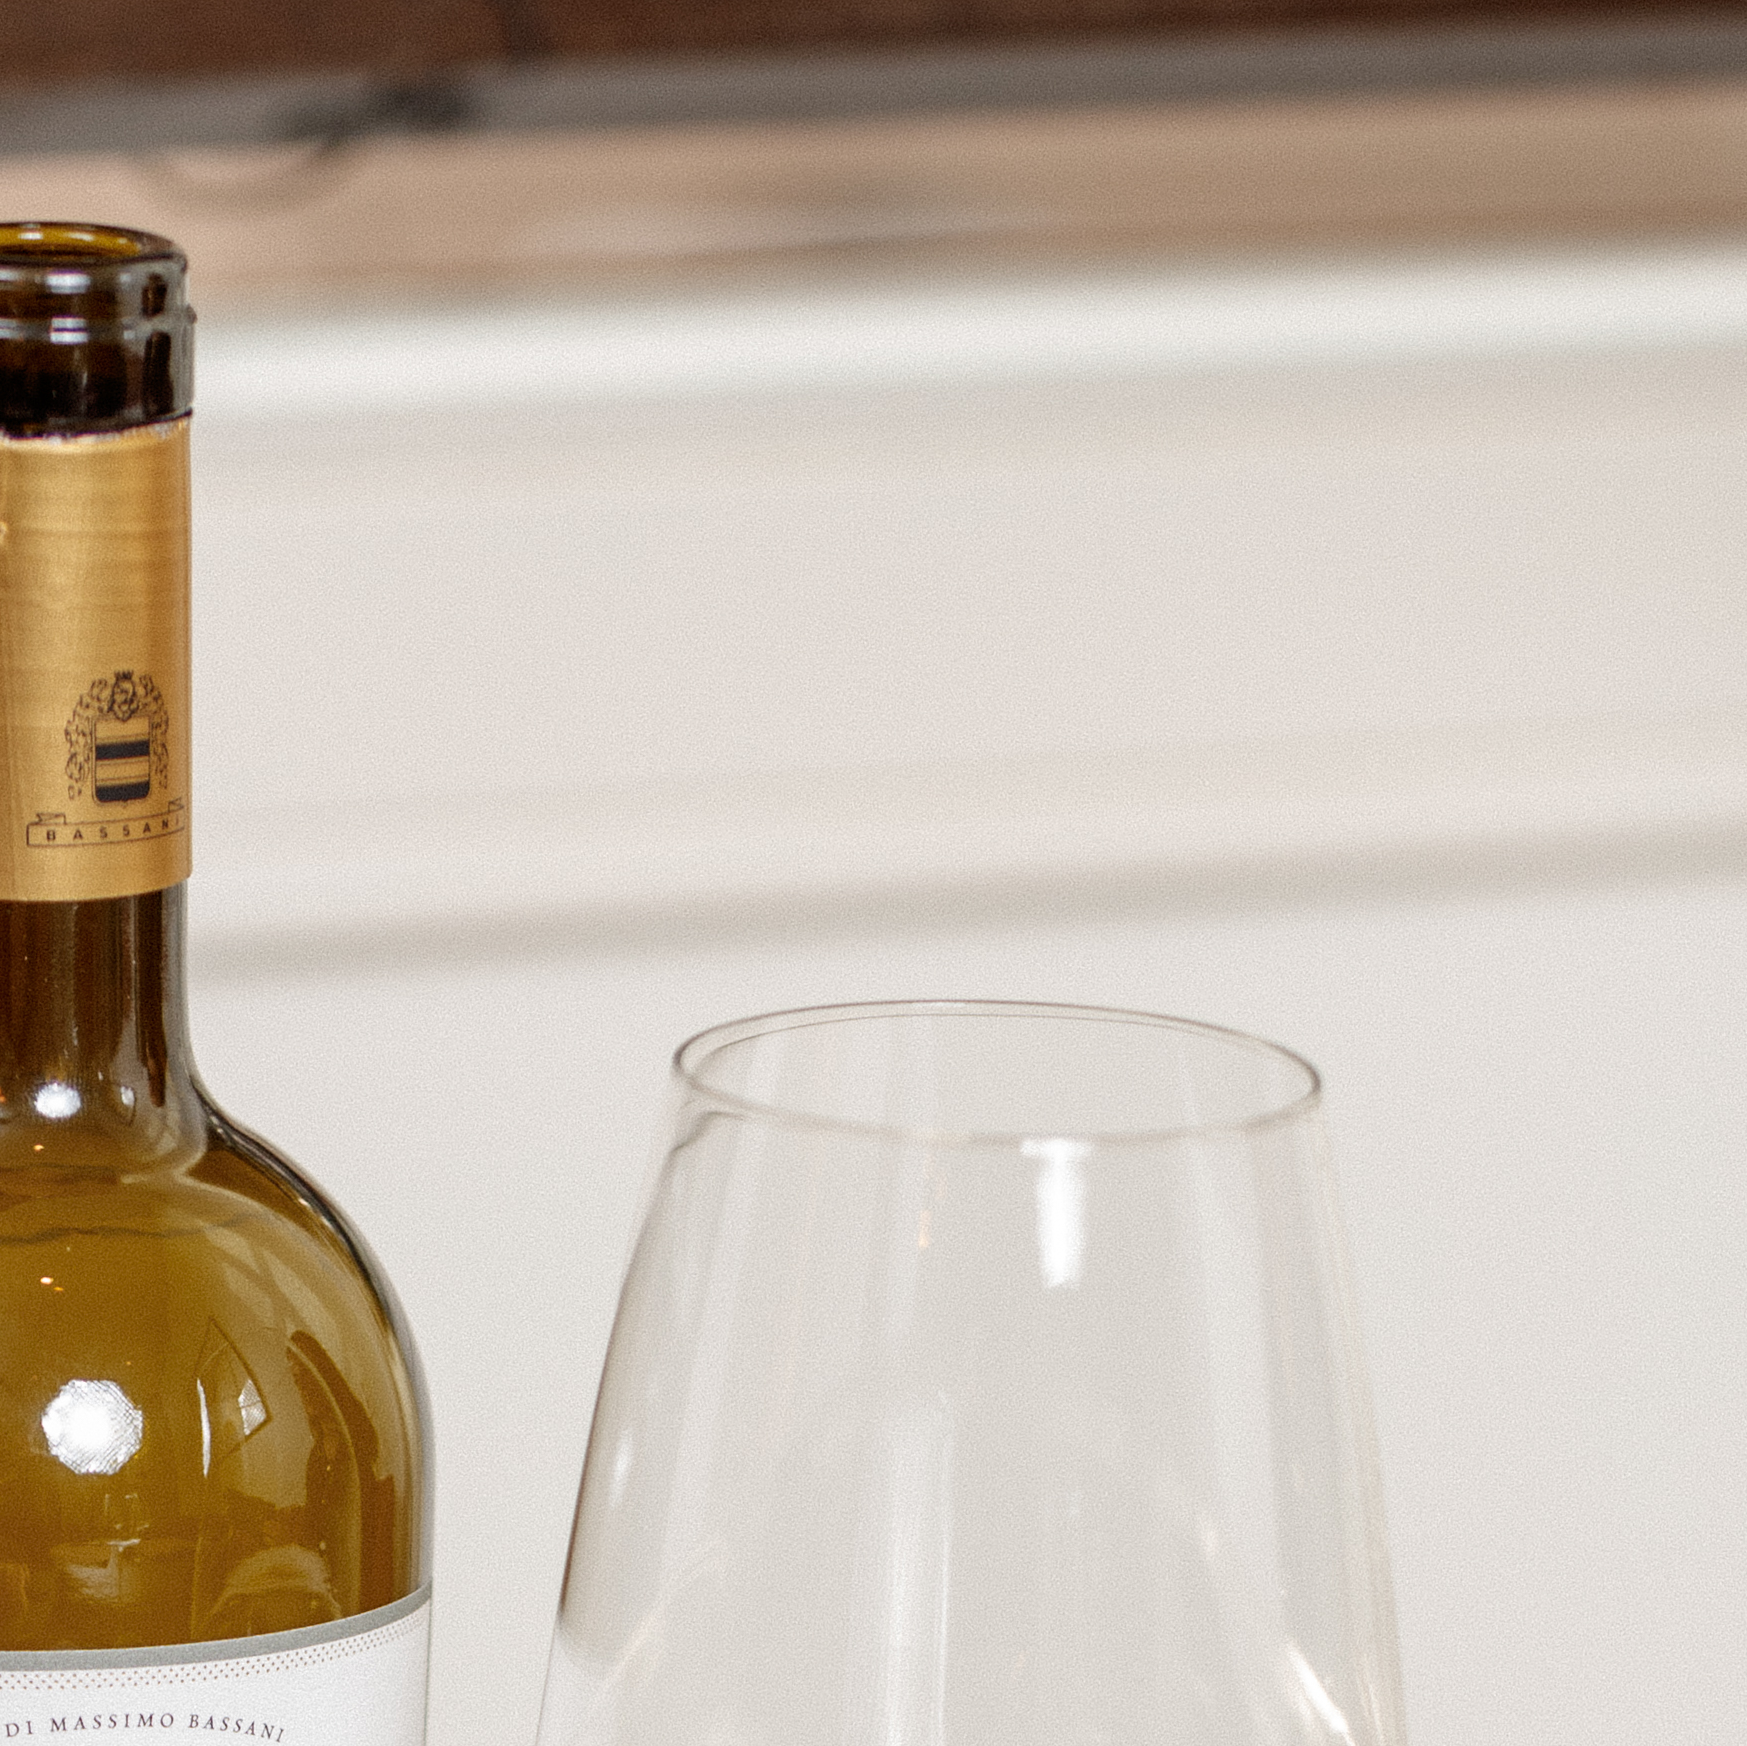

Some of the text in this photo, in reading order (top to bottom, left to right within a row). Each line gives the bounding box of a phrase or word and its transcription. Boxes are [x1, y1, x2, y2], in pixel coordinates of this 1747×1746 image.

[46, 816, 180, 842] BASSANI
[5, 1719, 34, 1739] DI
[49, 1713, 175, 1733] MASSIMO
[188, 1713, 286, 1744] BASSANI
